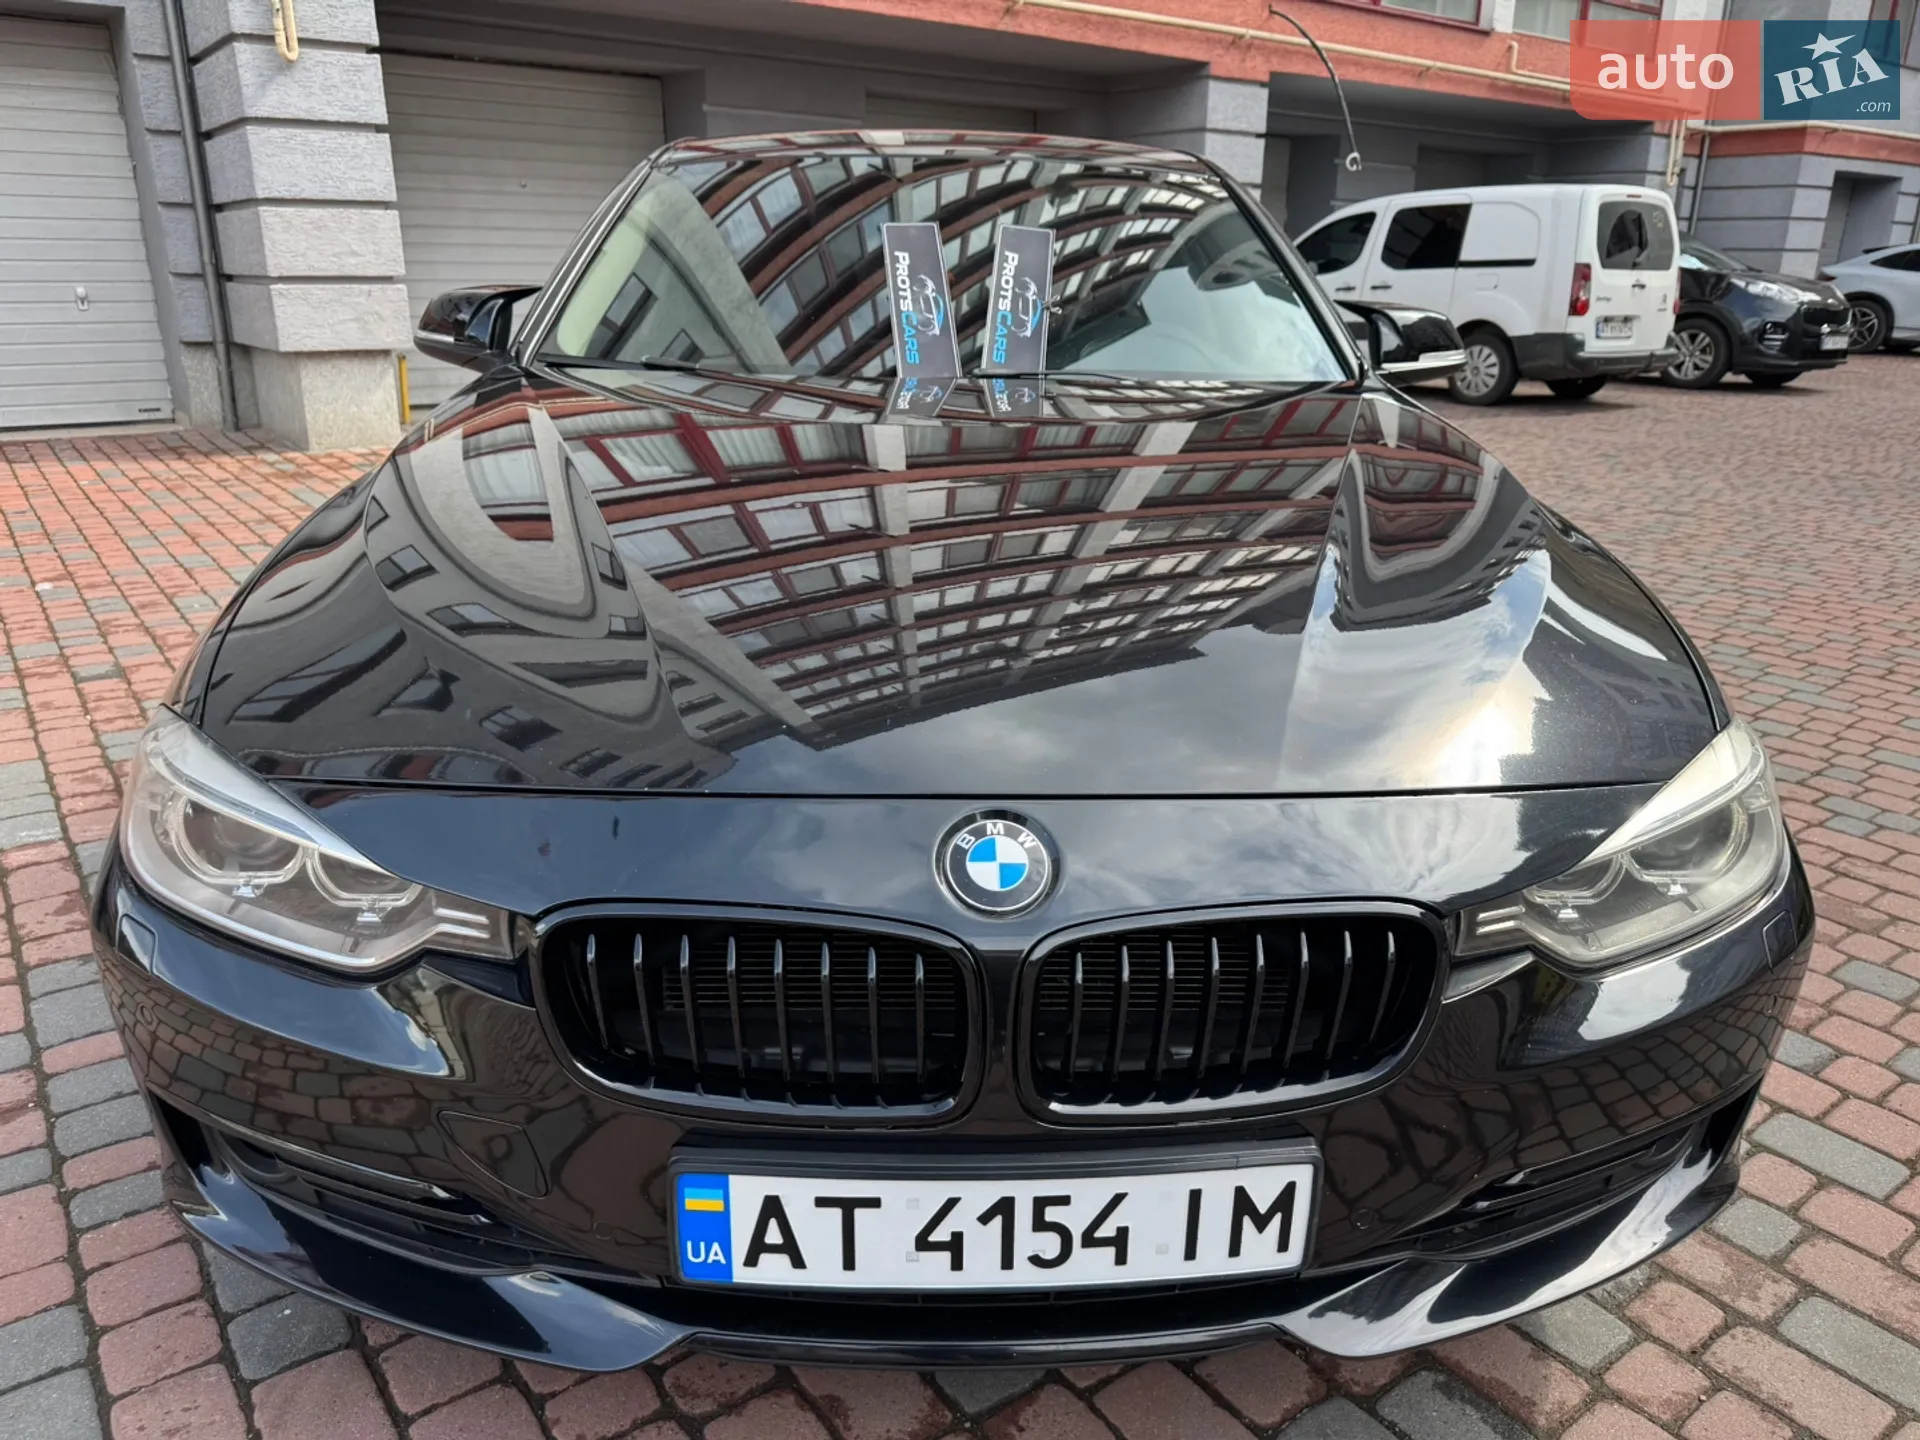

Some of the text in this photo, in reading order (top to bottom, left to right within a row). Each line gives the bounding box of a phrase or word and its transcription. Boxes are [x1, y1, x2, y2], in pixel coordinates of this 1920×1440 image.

[957, 823, 1036, 849] BMW
[743, 1181, 1297, 1271] AT 4154 IM
[687, 1240, 726, 1264] UA
